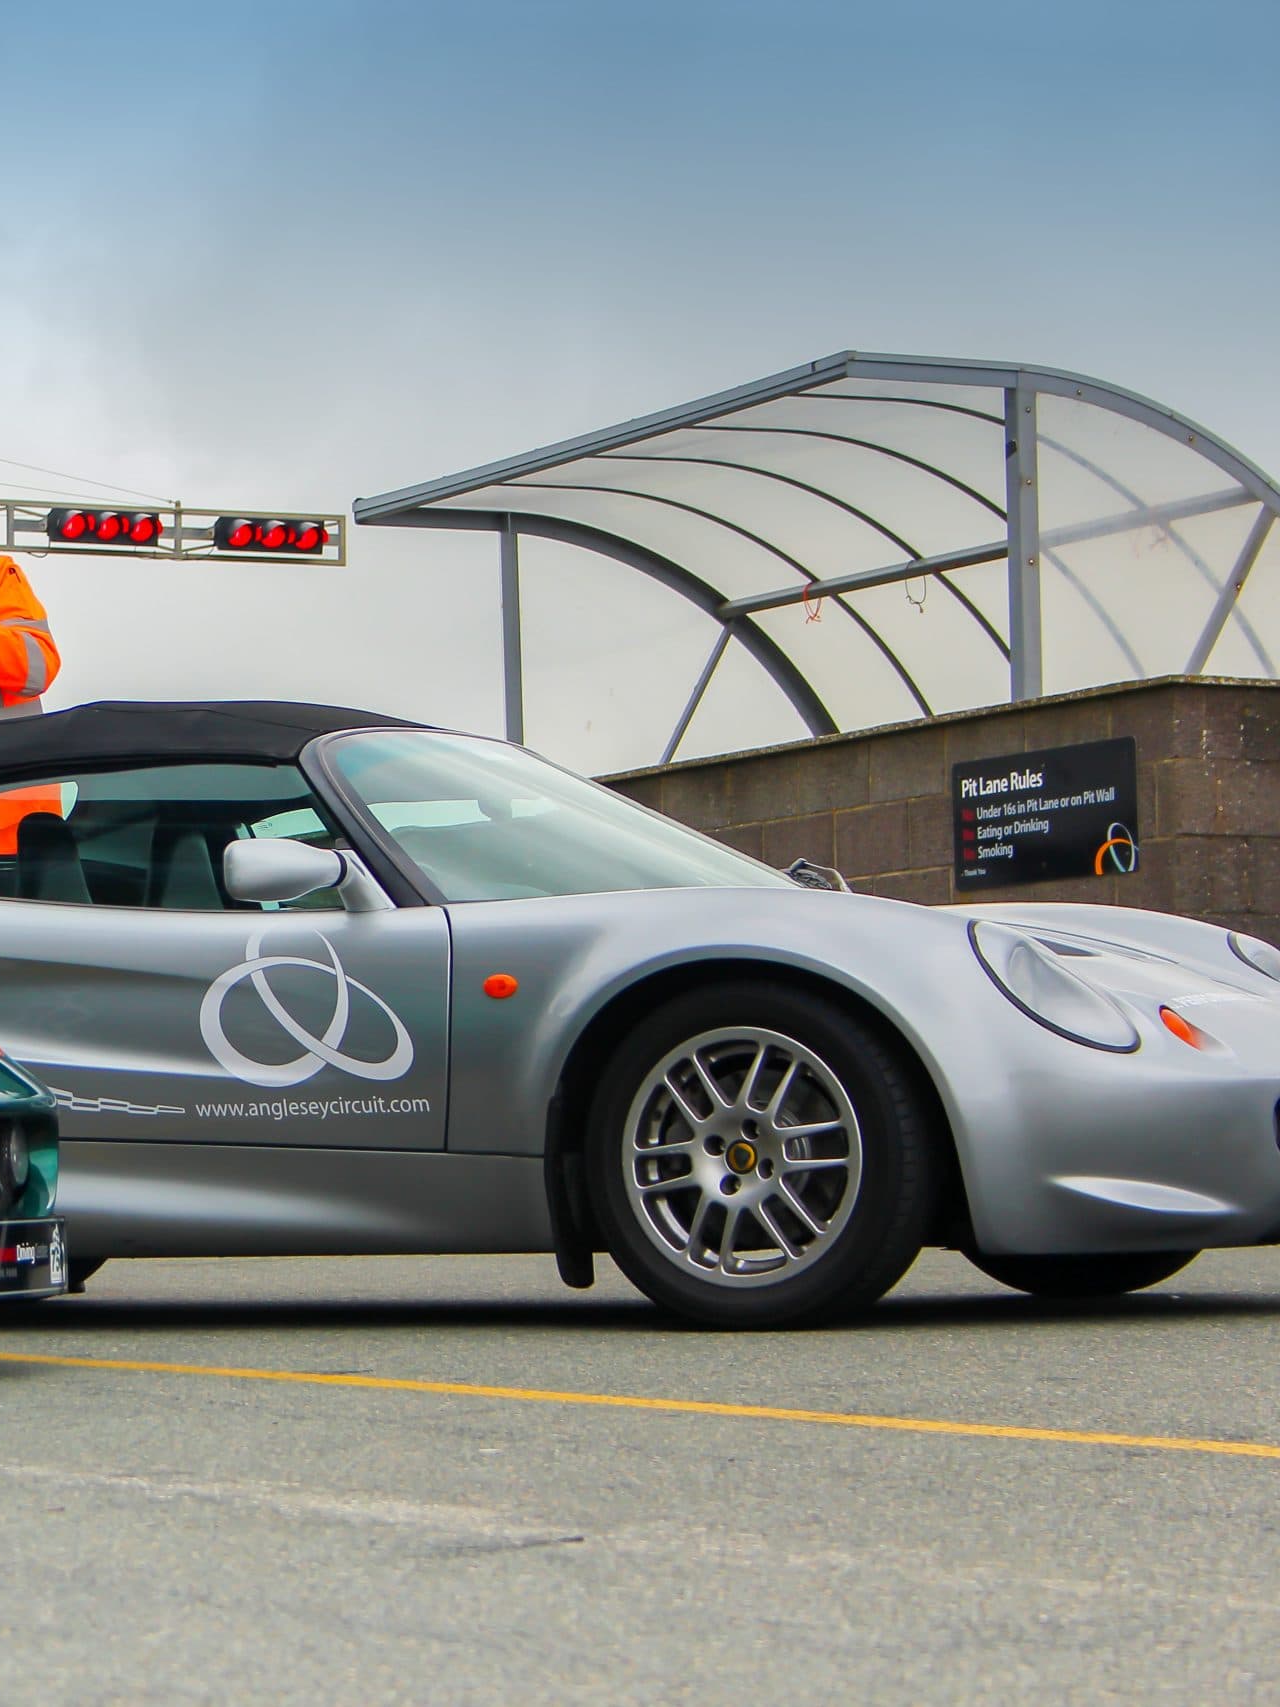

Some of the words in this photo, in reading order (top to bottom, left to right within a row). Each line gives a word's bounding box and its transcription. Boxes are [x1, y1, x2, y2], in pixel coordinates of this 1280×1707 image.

[961, 778, 978, 798] Pit
[979, 777, 1009, 796] Lane
[1010, 769, 1043, 791] Rules
[976, 805, 1001, 820] Under
[1003, 803, 1016, 816] 16s
[1017, 801, 1026, 813] in
[1026, 798, 1038, 812] Pit
[1039, 798, 1059, 811] Lane
[1060, 796, 1070, 808] or
[1070, 795, 1082, 806] on
[1083, 790, 1095, 804] Pit
[1096, 787, 1115, 803] Wall
[977, 824, 1003, 840] Eating
[1003, 825, 1013, 836] or
[1013, 818, 1049, 834] Drinking
[977, 842, 1014, 859] Smoking
[195, 1096, 431, 1120] www.angleseycircuit.com
